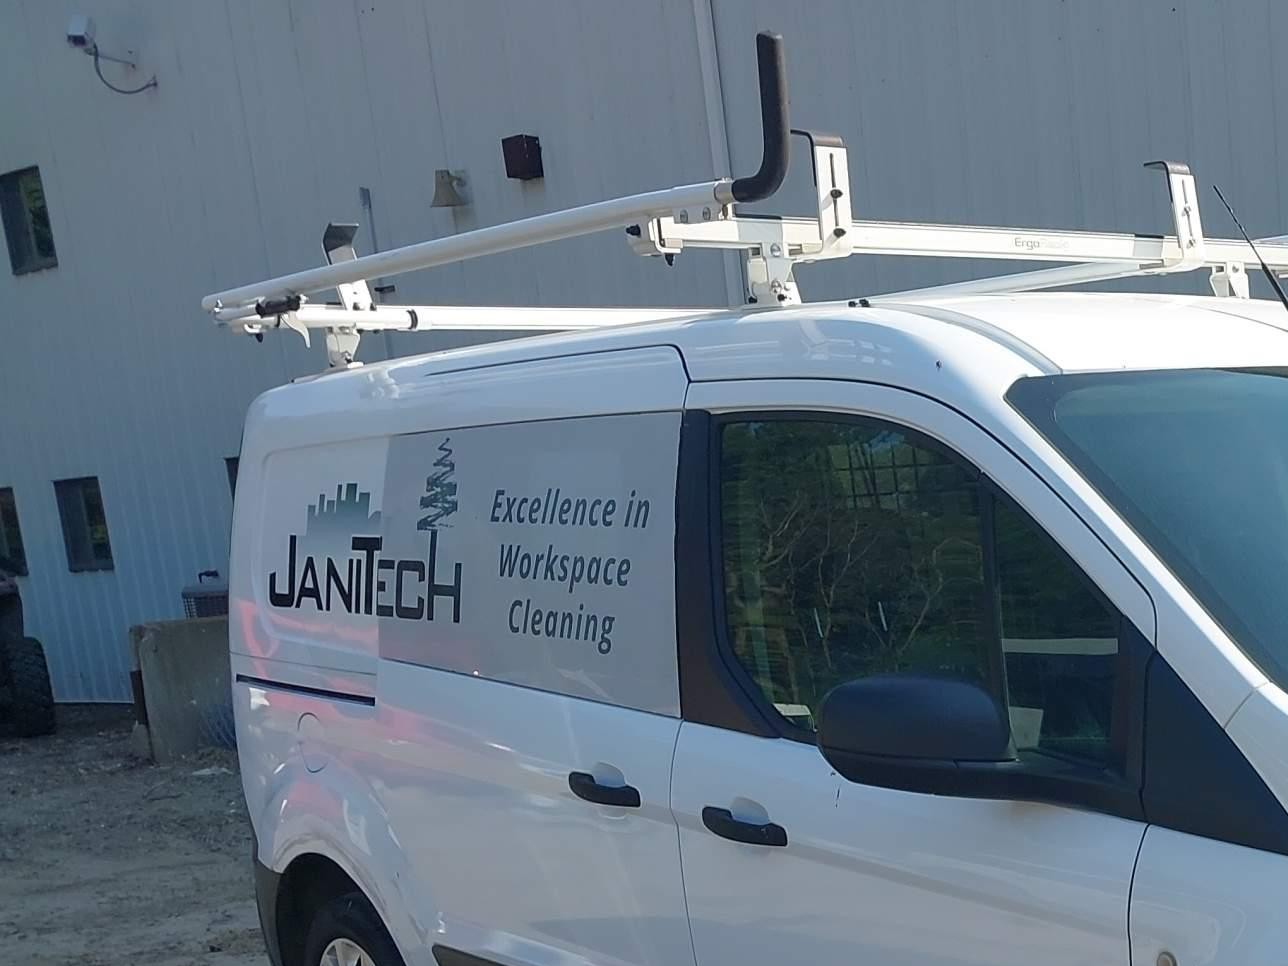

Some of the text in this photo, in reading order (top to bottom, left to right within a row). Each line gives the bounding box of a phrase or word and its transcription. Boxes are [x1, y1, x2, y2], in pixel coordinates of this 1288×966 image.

[490, 488, 650, 529] Excellence in
[499, 543, 631, 593] Workspace
[508, 599, 616, 654] Cleaning
